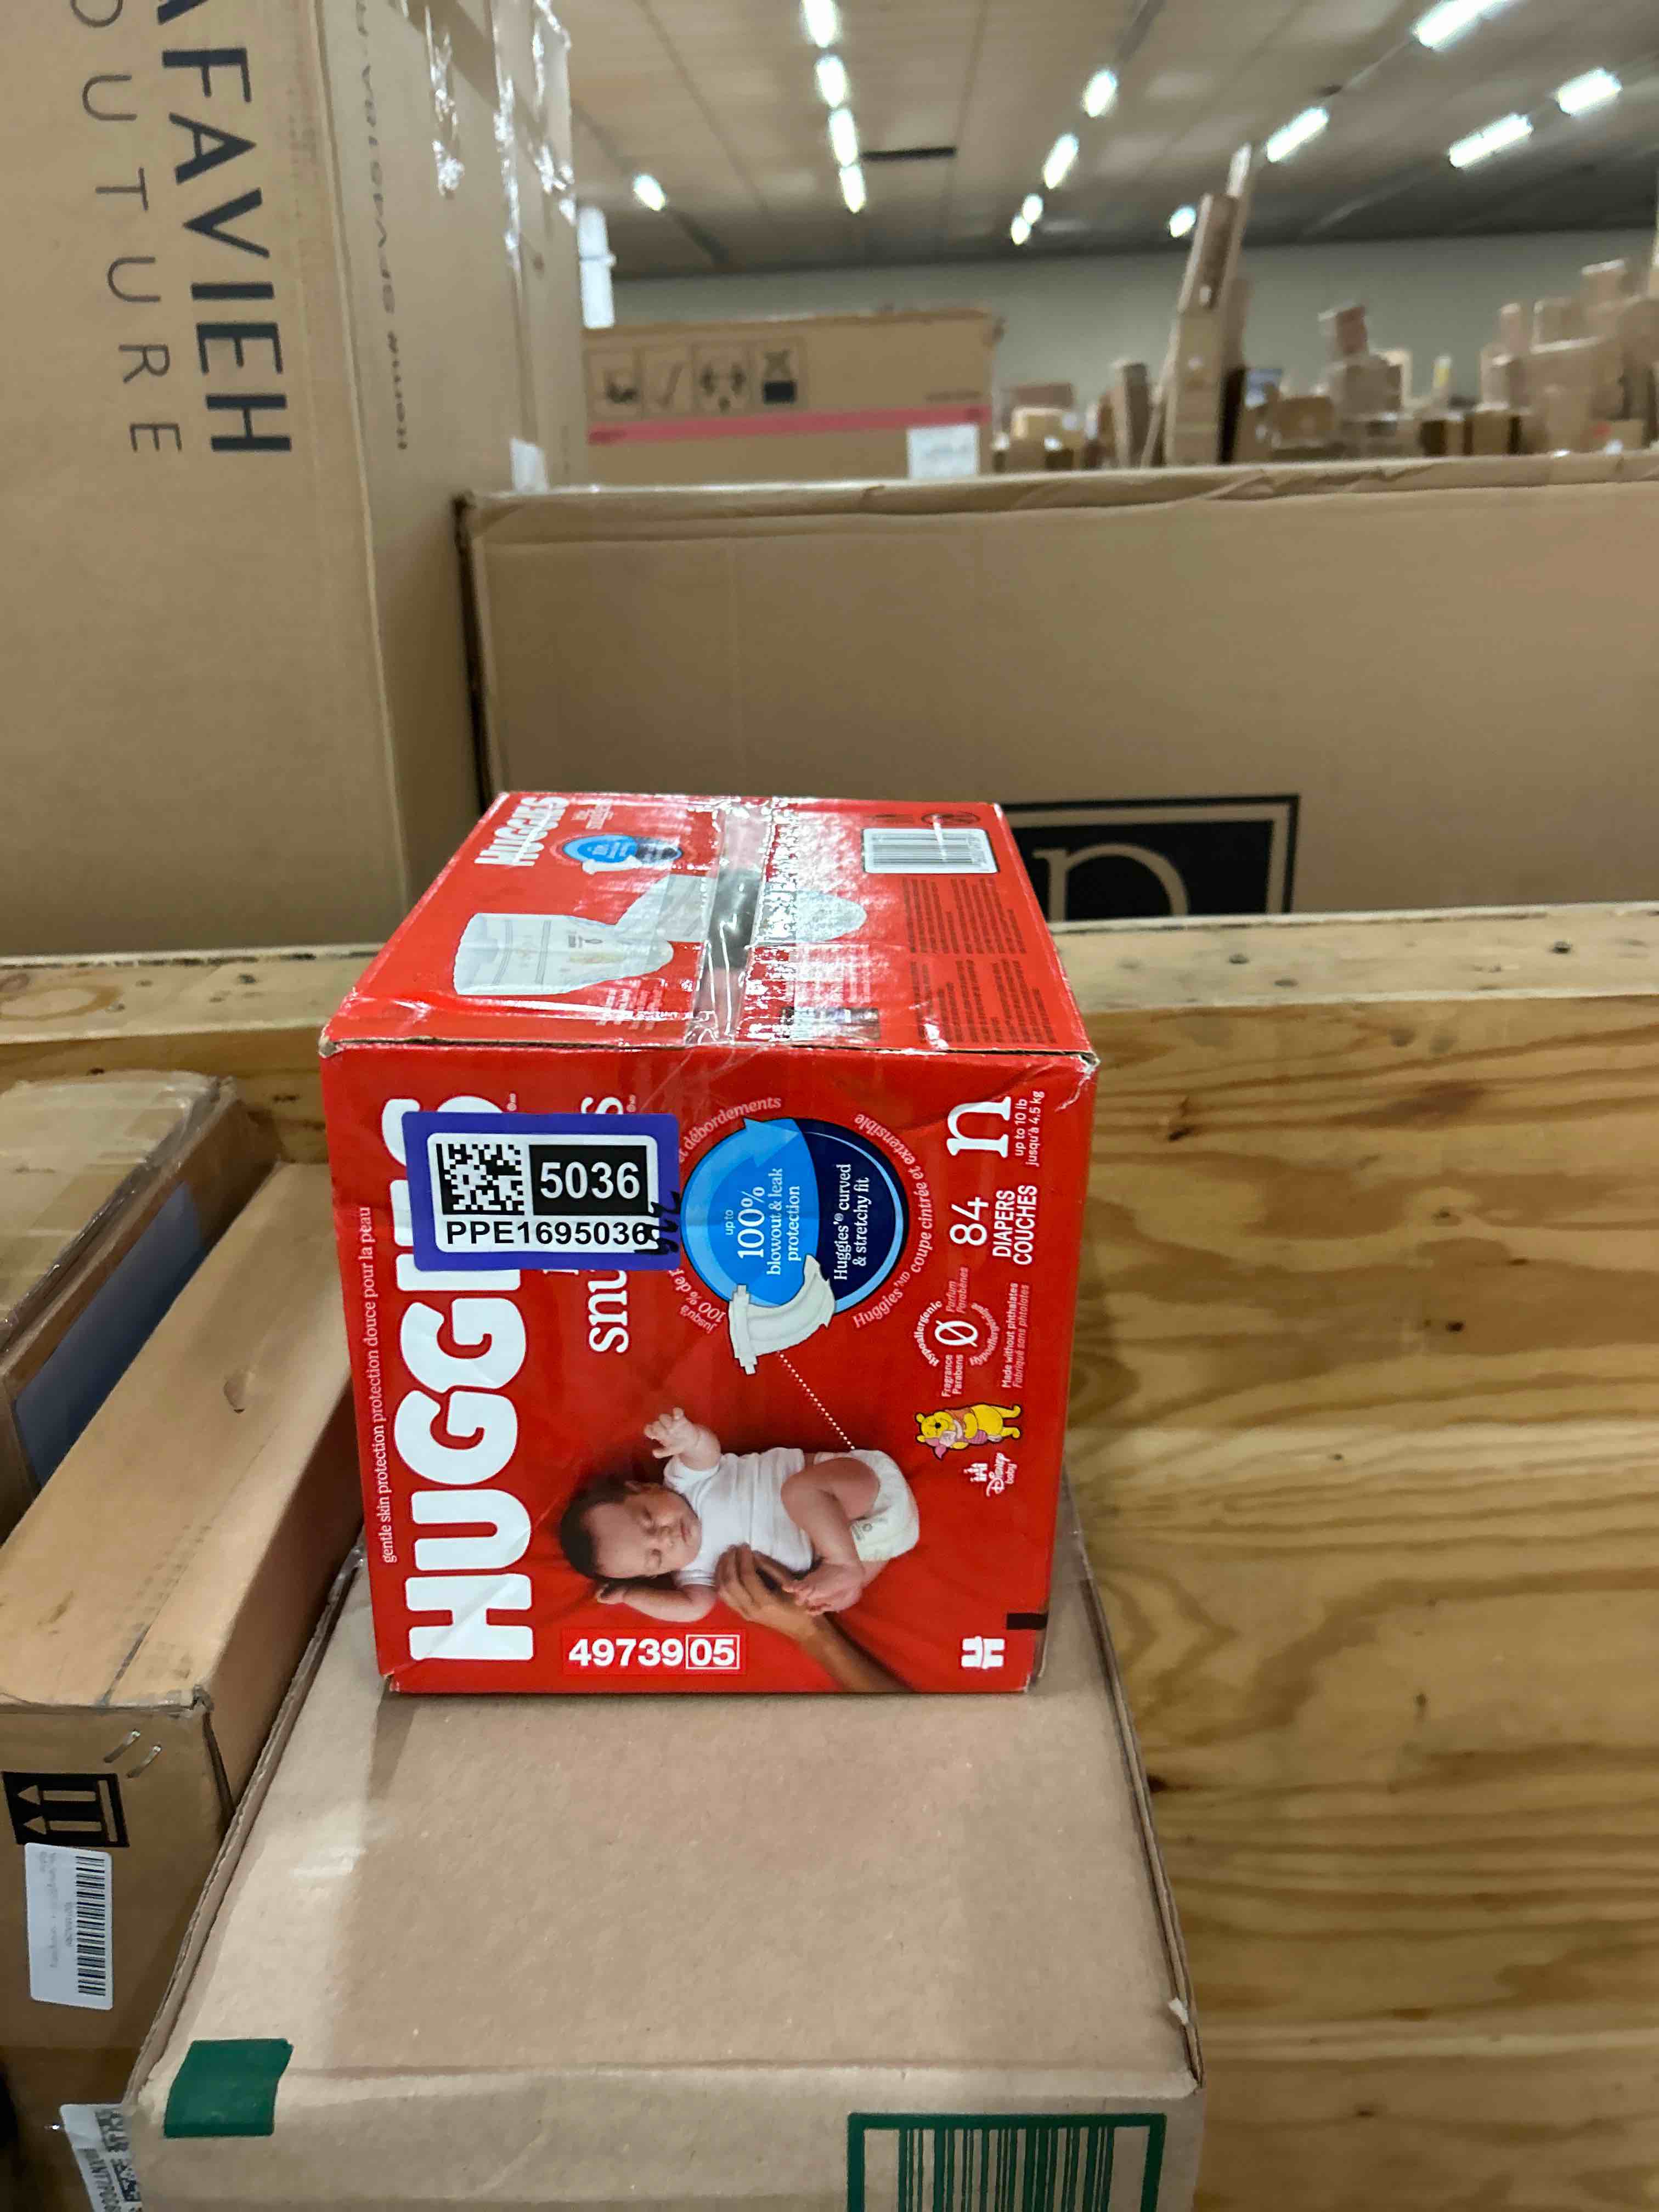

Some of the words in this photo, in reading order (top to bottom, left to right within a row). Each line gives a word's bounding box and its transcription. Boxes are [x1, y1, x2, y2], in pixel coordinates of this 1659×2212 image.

[475, 797, 569, 866] HUGGIES
[1016, 1099, 1027, 1109] lb
[1030, 1107, 1041, 1124] 4.5
[1031, 1091, 1044, 1104] kg
[681, 1097, 781, 1150] débordements
[946, 1096, 1011, 1158] n
[1014, 1128, 1025, 1139] to
[1015, 1113, 1026, 1125] 10
[853, 1114, 915, 1165] extensible
[1014, 1142, 1025, 1155] up
[540, 1161, 641, 1199] 5036
[770, 1168, 783, 1197] leak
[836, 1164, 851, 1210] curved
[855, 1177, 870, 1192] fit
[909, 1165, 924, 1180] et
[726, 1210, 733, 1220] to
[736, 1187, 765, 1259] 100%
[771, 1201, 782, 1210] &
[786, 1186, 801, 1261] protection
[913, 1182, 932, 1229] cintrée
[949, 1197, 989, 1246] 84
[992, 1190, 1014, 1257] DIAPERS
[358, 1207, 373, 1243] peau
[447, 1221, 651, 1245] PPE1695036
[726, 1222, 735, 1235] up
[855, 1195, 871, 1253] stretchy
[1013, 1185, 1037, 1265] COUCHES
[358, 1246, 373, 1260] la
[768, 1214, 782, 1275] blowout
[853, 1257, 867, 1266] &
[910, 1232, 933, 1273] coupe
[362, 1262, 378, 1298] pour
[674, 1276, 692, 1292] de
[688, 1291, 701, 1305] %
[946, 1281, 957, 1312] Parfum
[362, 1302, 377, 1346] douce
[698, 1301, 726, 1323] 100
[1006, 1283, 1018, 1329] phthalates
[913, 1300, 943, 1367] Hypoallergenic
[1004, 1331, 1015, 1363] without
[1018, 1329, 1026, 1348] sans
[368, 1350, 386, 1422] protection
[942, 1355, 953, 1397] Fragrance
[953, 1355, 963, 1395] Parabens
[1002, 1365, 1013, 1387] Made
[373, 1426, 392, 1494] protection
[985, 1453, 1009, 1497] Disney
[1006, 1464, 1017, 1484] baby
[376, 1497, 390, 1522] skin
[379, 1525, 396, 1564] gentle
